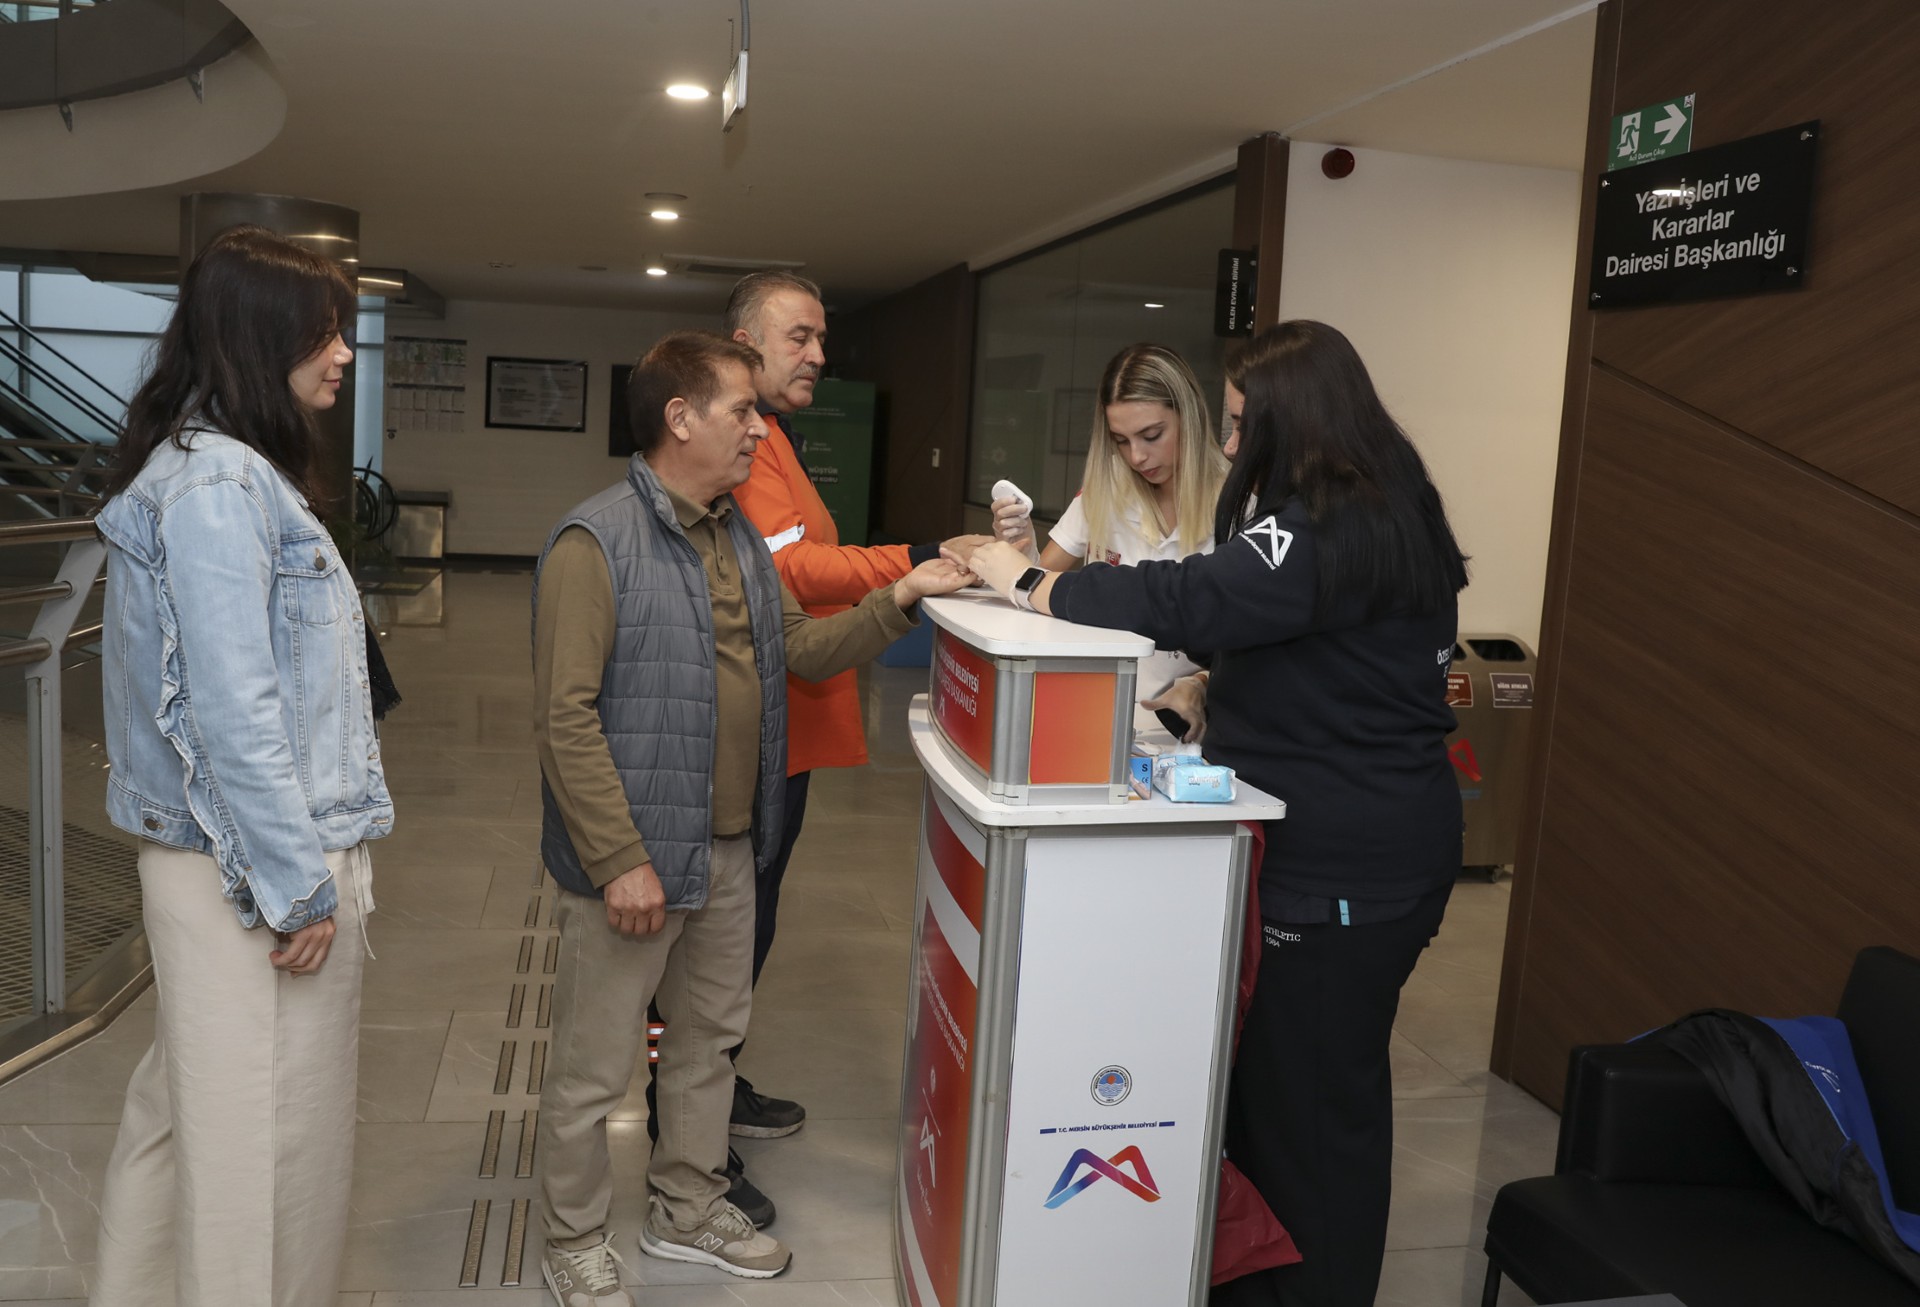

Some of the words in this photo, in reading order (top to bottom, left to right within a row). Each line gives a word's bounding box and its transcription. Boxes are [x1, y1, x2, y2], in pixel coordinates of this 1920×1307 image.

[1638, 151, 1652, 160] Durum
[1635, 190, 1673, 214] Yazı
[1679, 174, 1729, 210] İşleri
[1735, 172, 1761, 194] ve
[1652, 209, 1735, 241] Kararlar
[1605, 247, 1668, 278] Dairesi
[1674, 229, 1786, 270] Başkanlığı
[1141, 763, 1148, 772] S
[1263, 925, 1301, 942] ATHLETIC
[1091, 1123, 1126, 1131] BÜYÜKŞEHİR
[1127, 1121, 1157, 1129] BELEDİYESİ
[694, 1231, 724, 1253] N
[554, 1270, 573, 1292] N
